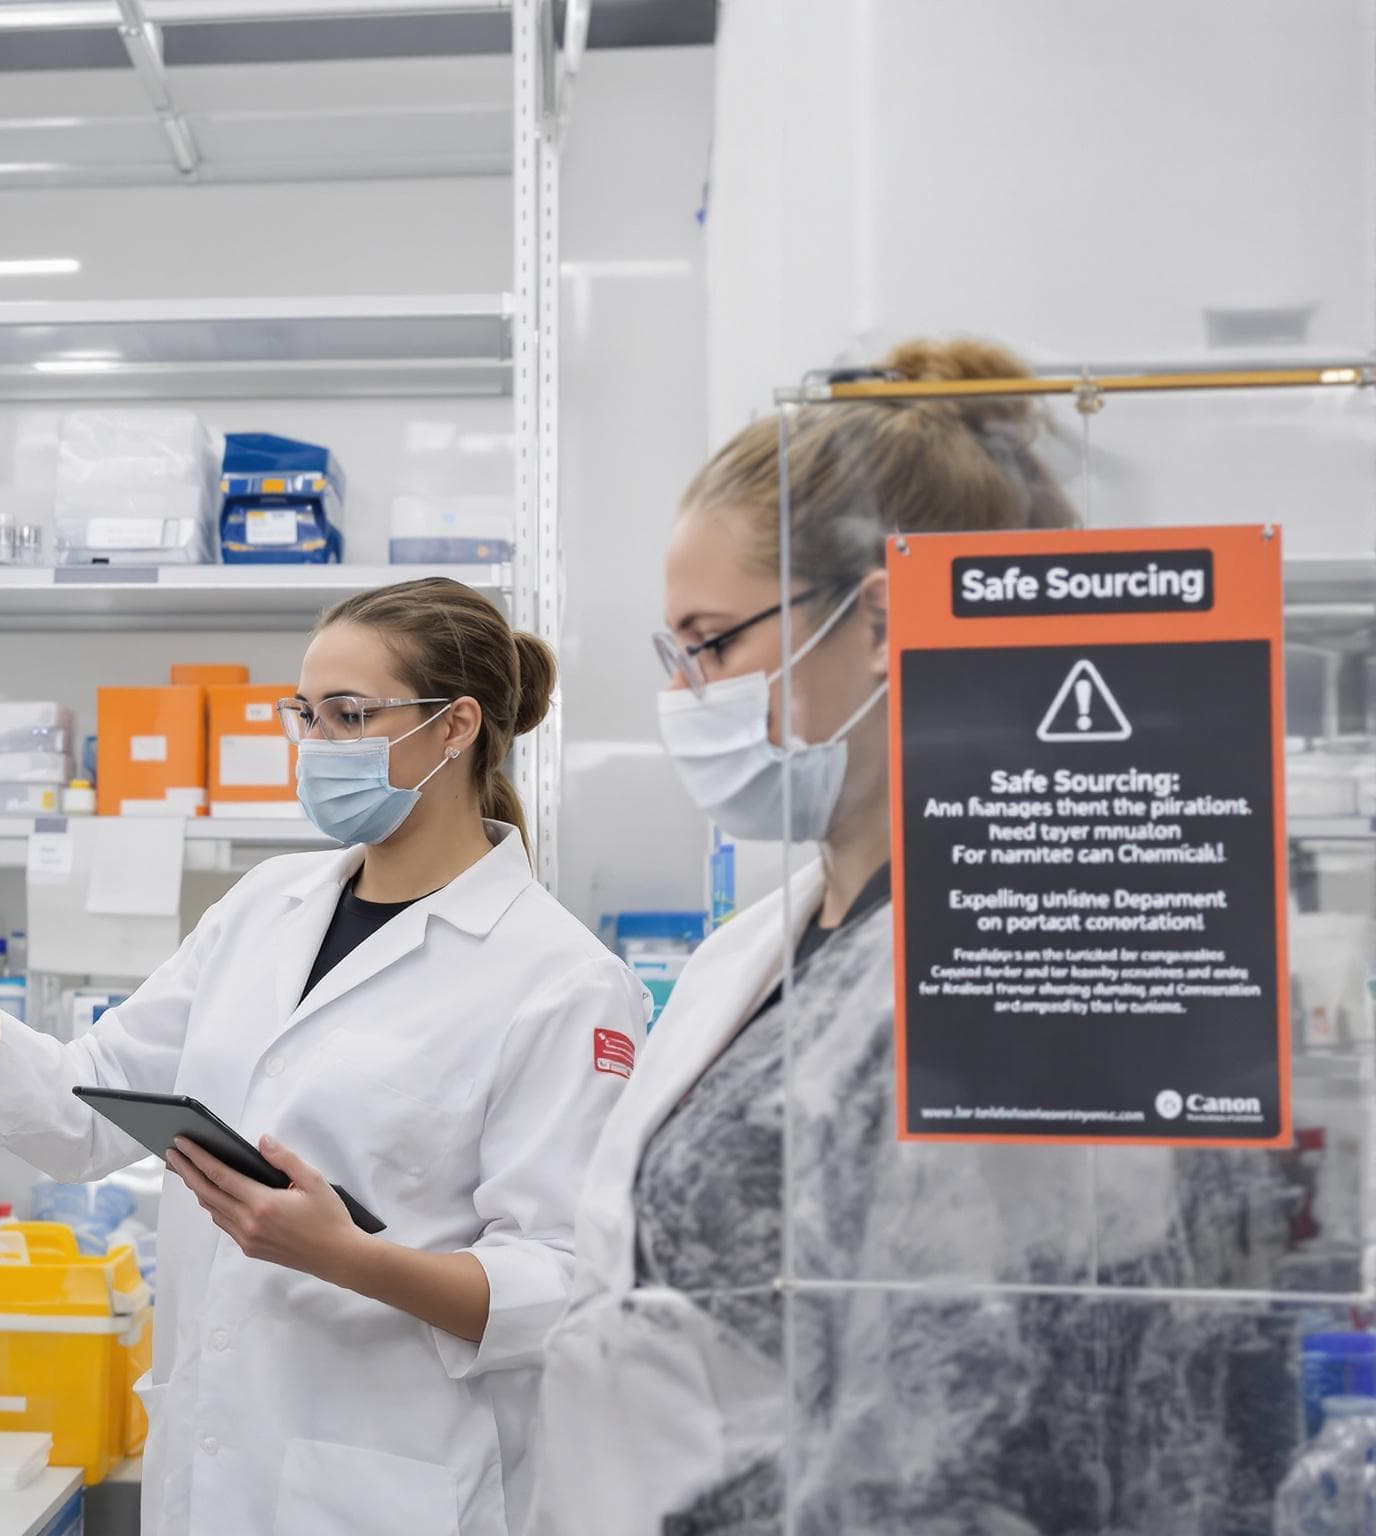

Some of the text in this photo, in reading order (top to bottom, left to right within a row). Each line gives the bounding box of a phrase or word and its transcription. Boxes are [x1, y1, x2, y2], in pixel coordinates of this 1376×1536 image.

[962, 563, 1204, 602] Safe Sourcing
[991, 768, 1180, 798] Safe Sourcing:
[1113, 797, 1147, 816] the
[952, 845, 986, 864] For
[949, 888, 1038, 912] Expelling
[977, 916, 1002, 930] on
[1186, 1094, 1260, 1113] Canon
